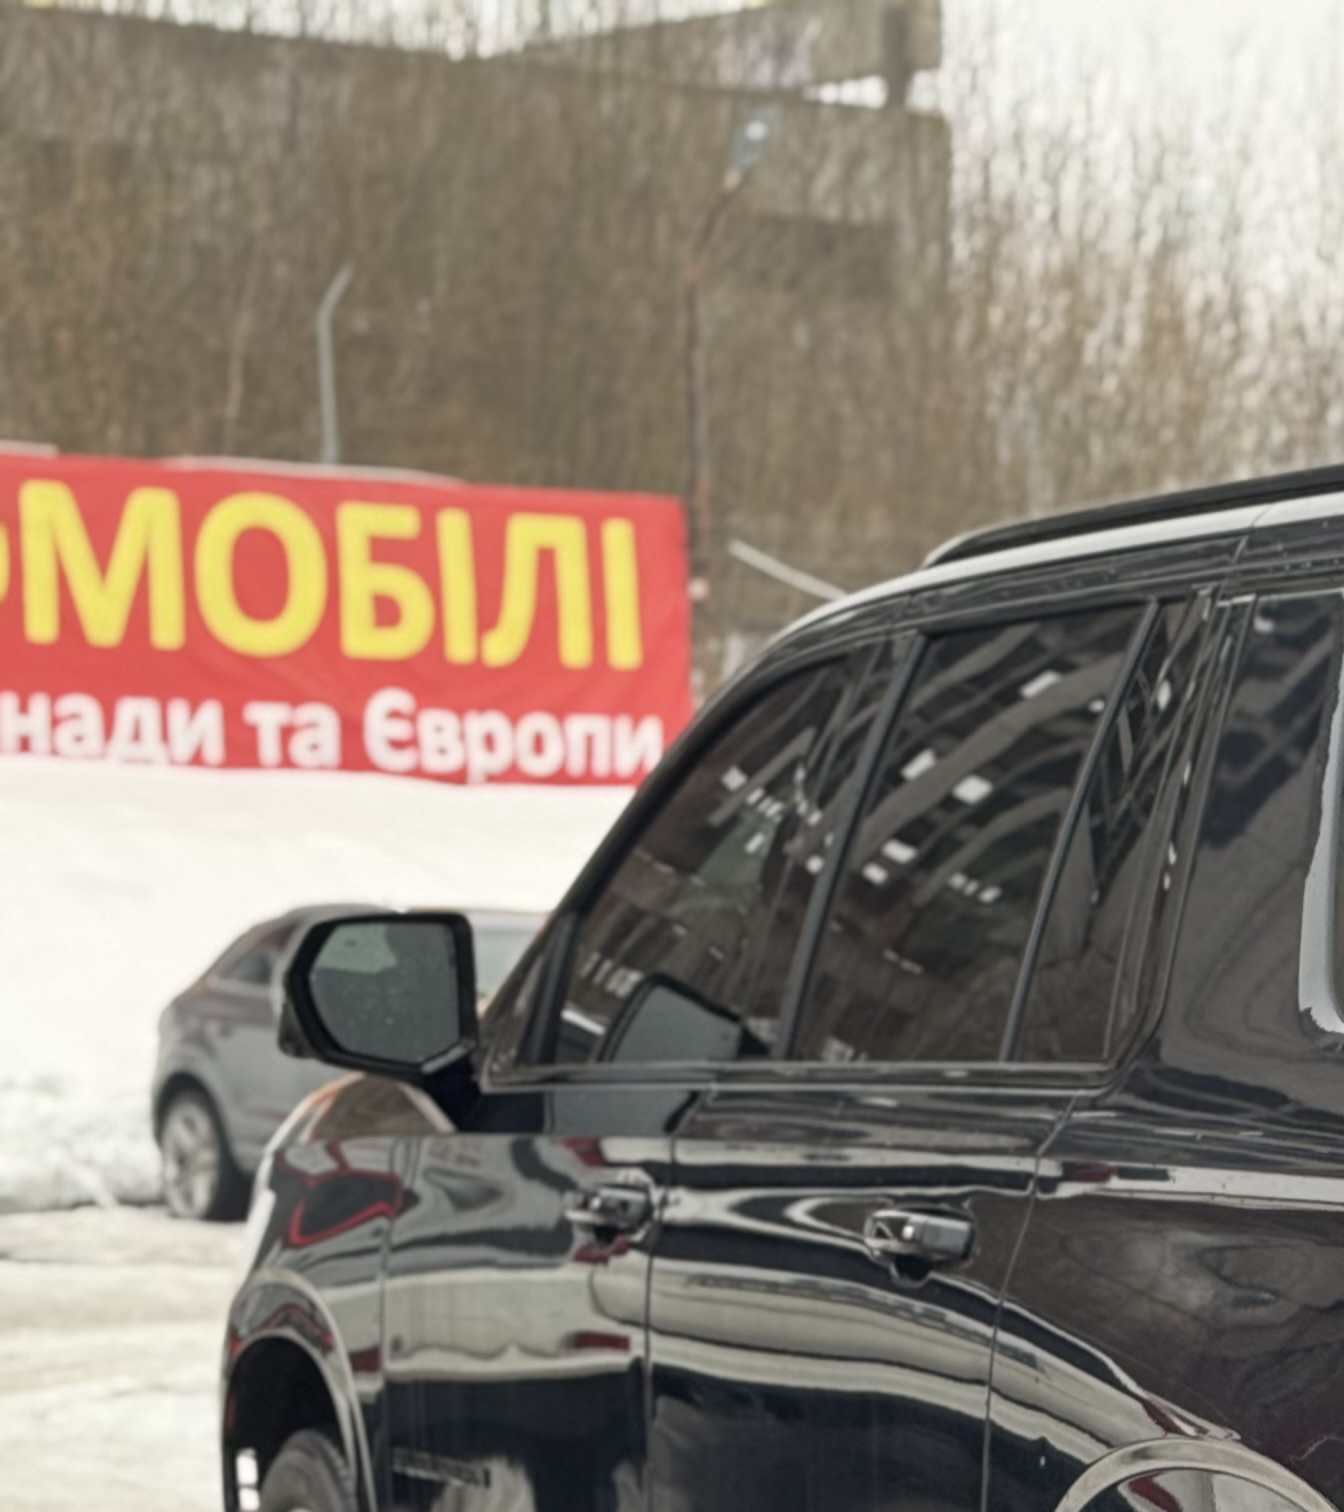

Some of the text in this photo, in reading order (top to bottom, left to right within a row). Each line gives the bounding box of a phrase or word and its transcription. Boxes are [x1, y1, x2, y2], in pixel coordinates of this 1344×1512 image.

[0, 479, 644, 671] МОБІЛІ
[243, 701, 341, 769] та
[363, 687, 664, 784] Європи
